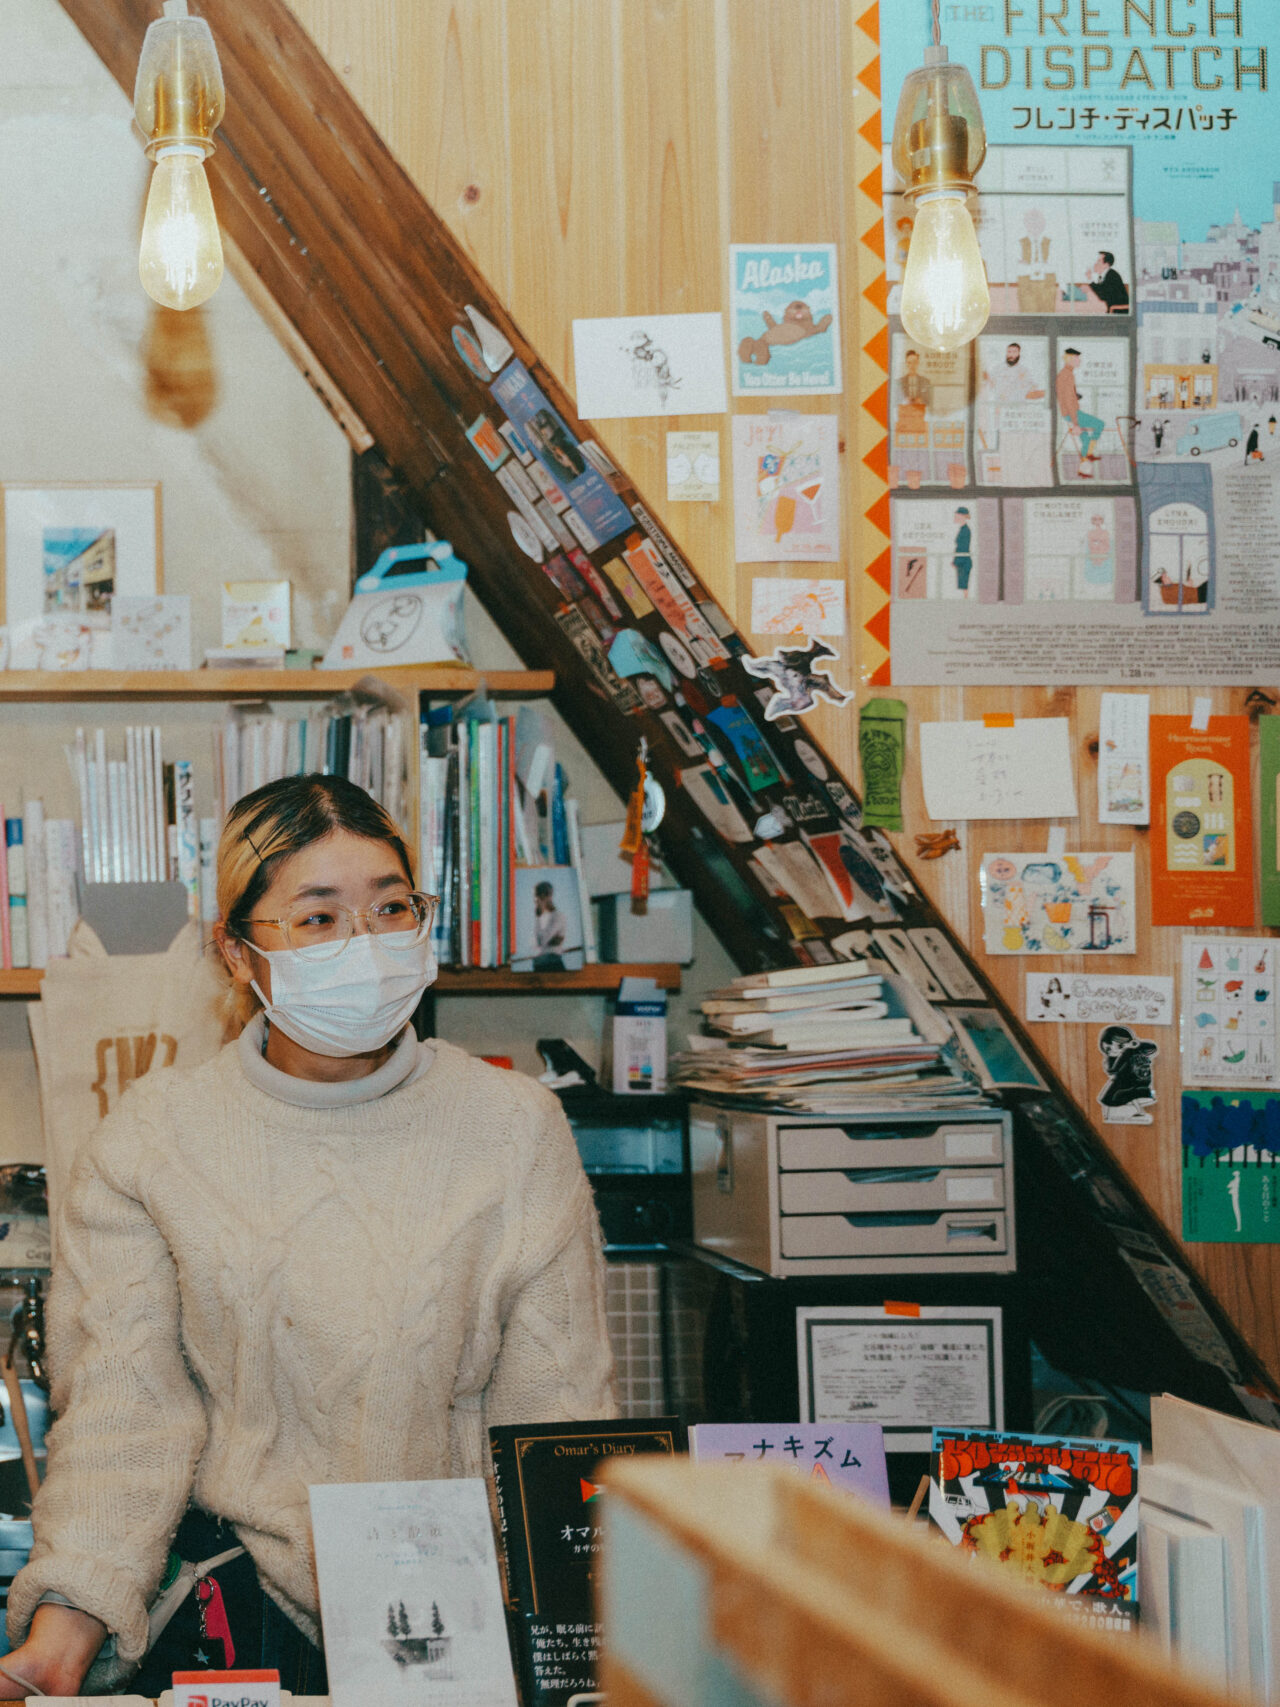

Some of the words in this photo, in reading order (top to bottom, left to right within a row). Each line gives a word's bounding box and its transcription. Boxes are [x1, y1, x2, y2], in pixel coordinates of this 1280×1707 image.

[951, 6, 989, 22] THE
[1003, 0, 1242, 37] FRENCH
[980, 45, 1267, 91] DISPATCH
[1012, 104, 1237, 130] フレンチ・ディスパッチ
[742, 253, 825, 290] Alaska
[743, 371, 761, 386] You
[762, 371, 786, 386] Otter
[788, 371, 801, 386] Be
[802, 370, 830, 386] Here!
[554, 1442, 599, 1456] Omar's
[602, 1441, 636, 1456] Diary
[211, 1697, 269, 1707] PayPay
